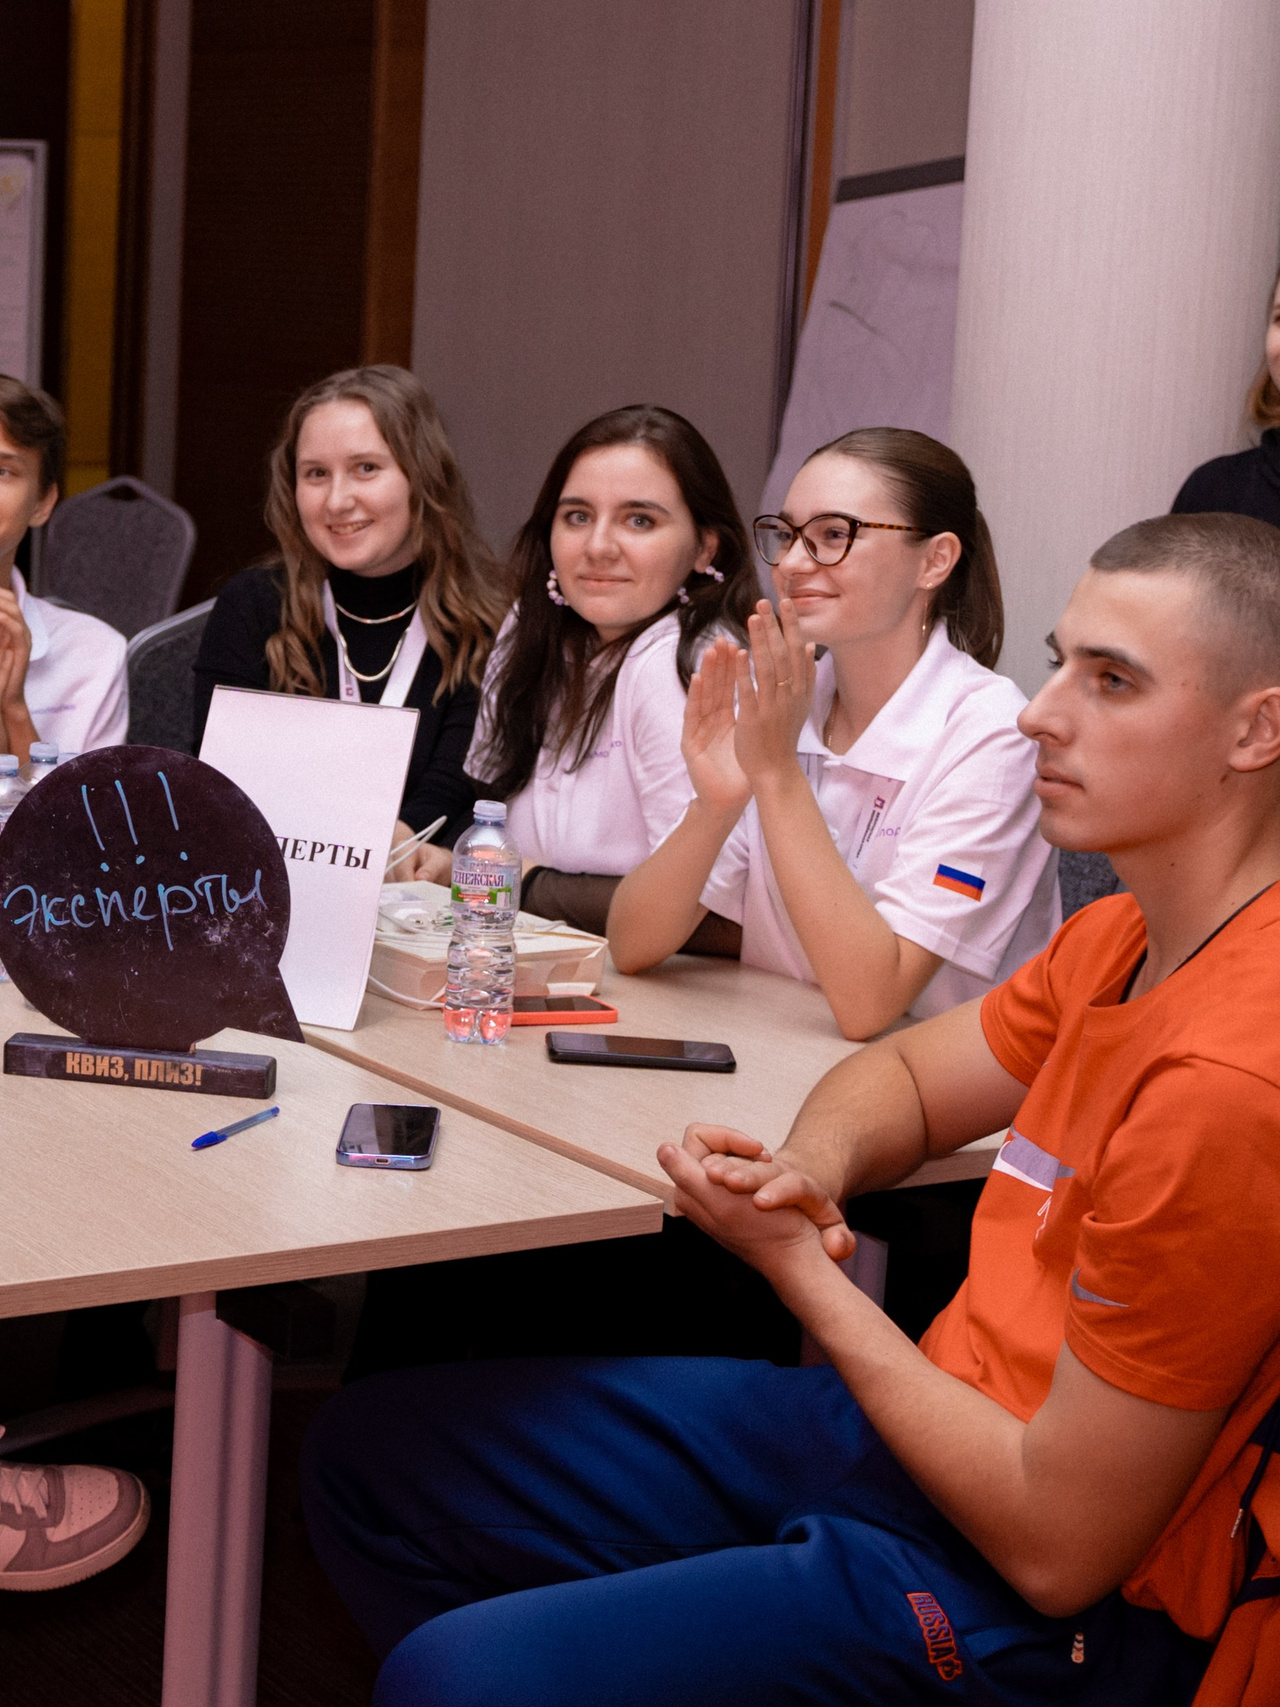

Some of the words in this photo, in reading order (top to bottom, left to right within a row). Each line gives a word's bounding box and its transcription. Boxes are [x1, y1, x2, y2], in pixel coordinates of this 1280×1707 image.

[453, 870, 505, 887] ЕНЕЖСКАЯ
[65, 1052, 130, 1082] КВИЗ,
[134, 1058, 203, 1087] ПЛИЗ!
[910, 1594, 956, 1661] RUSSIA
